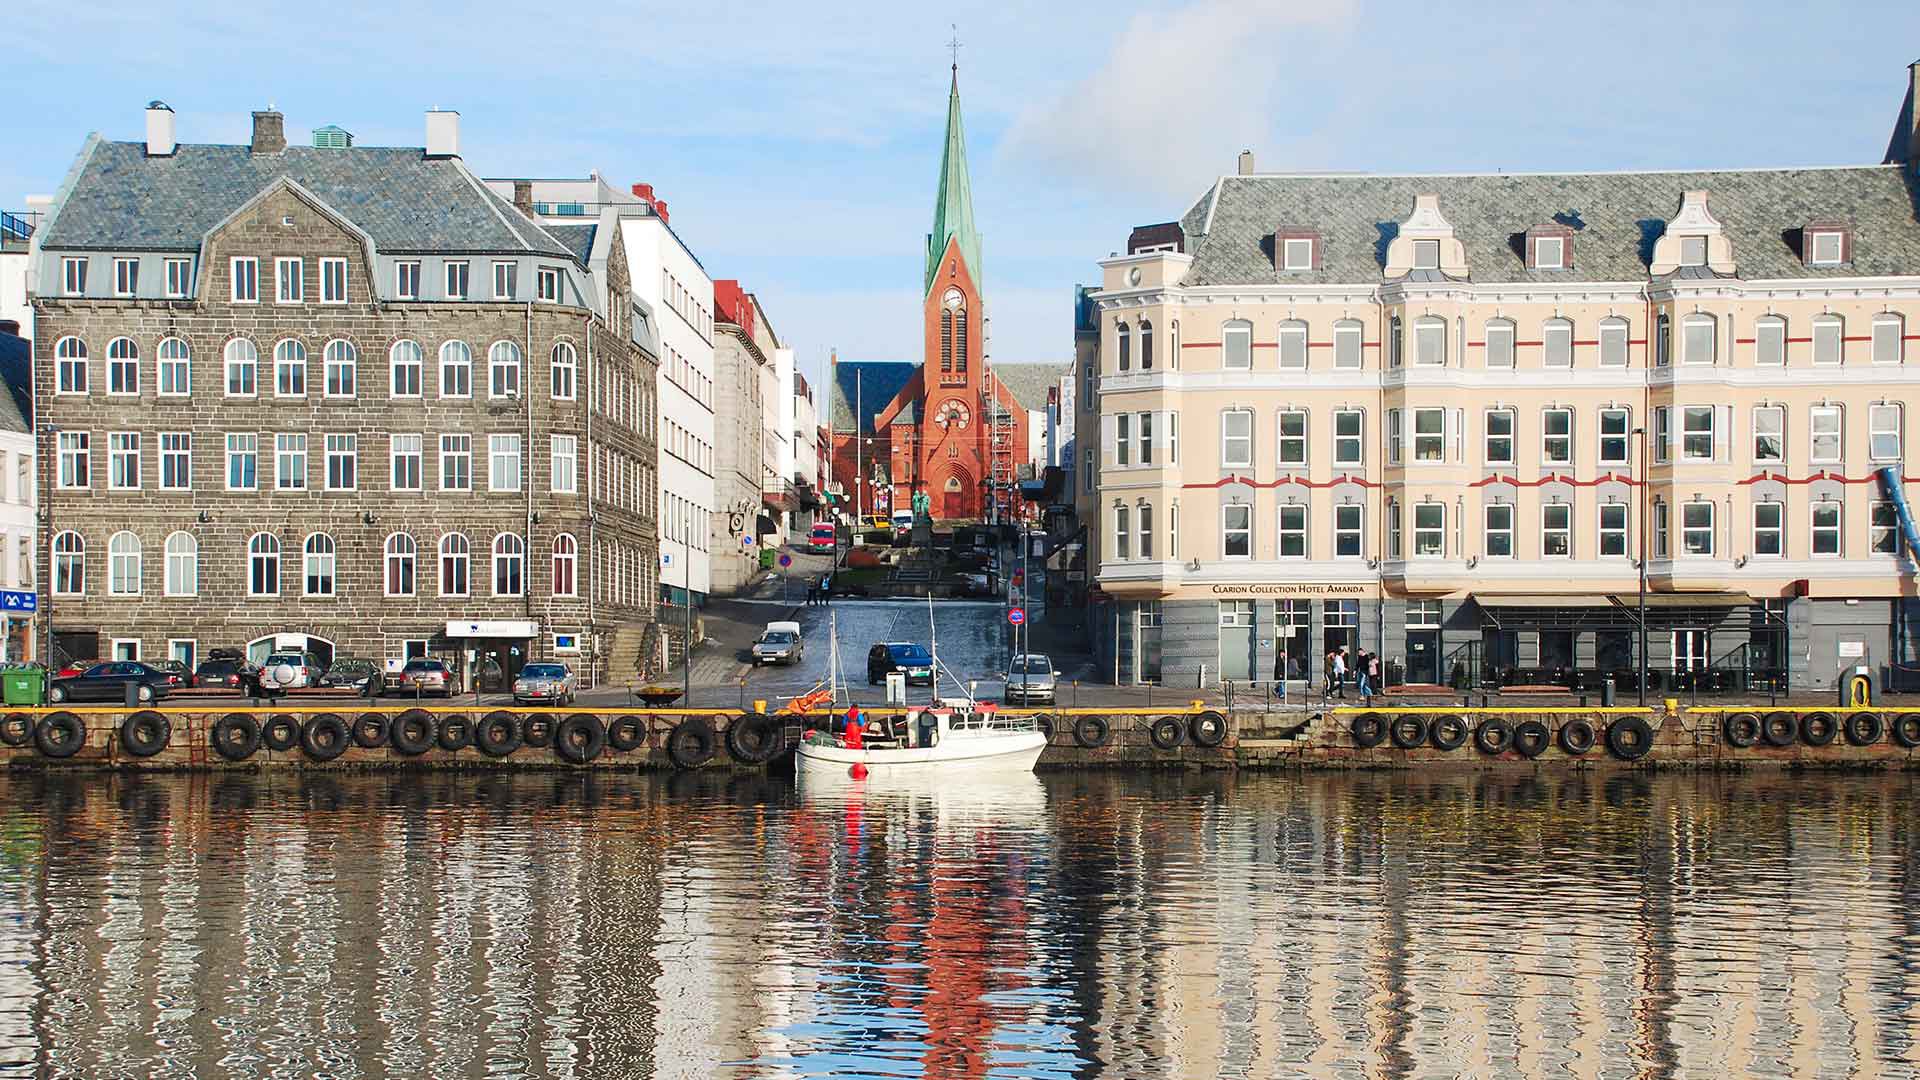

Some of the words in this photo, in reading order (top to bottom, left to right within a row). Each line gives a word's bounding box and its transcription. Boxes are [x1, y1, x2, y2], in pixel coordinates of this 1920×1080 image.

[1212, 584, 1247, 593] CLARION
[1249, 584, 1297, 593] COLLECTION
[1298, 584, 1325, 593] HOTEL
[1327, 584, 1364, 593] AMANDA
